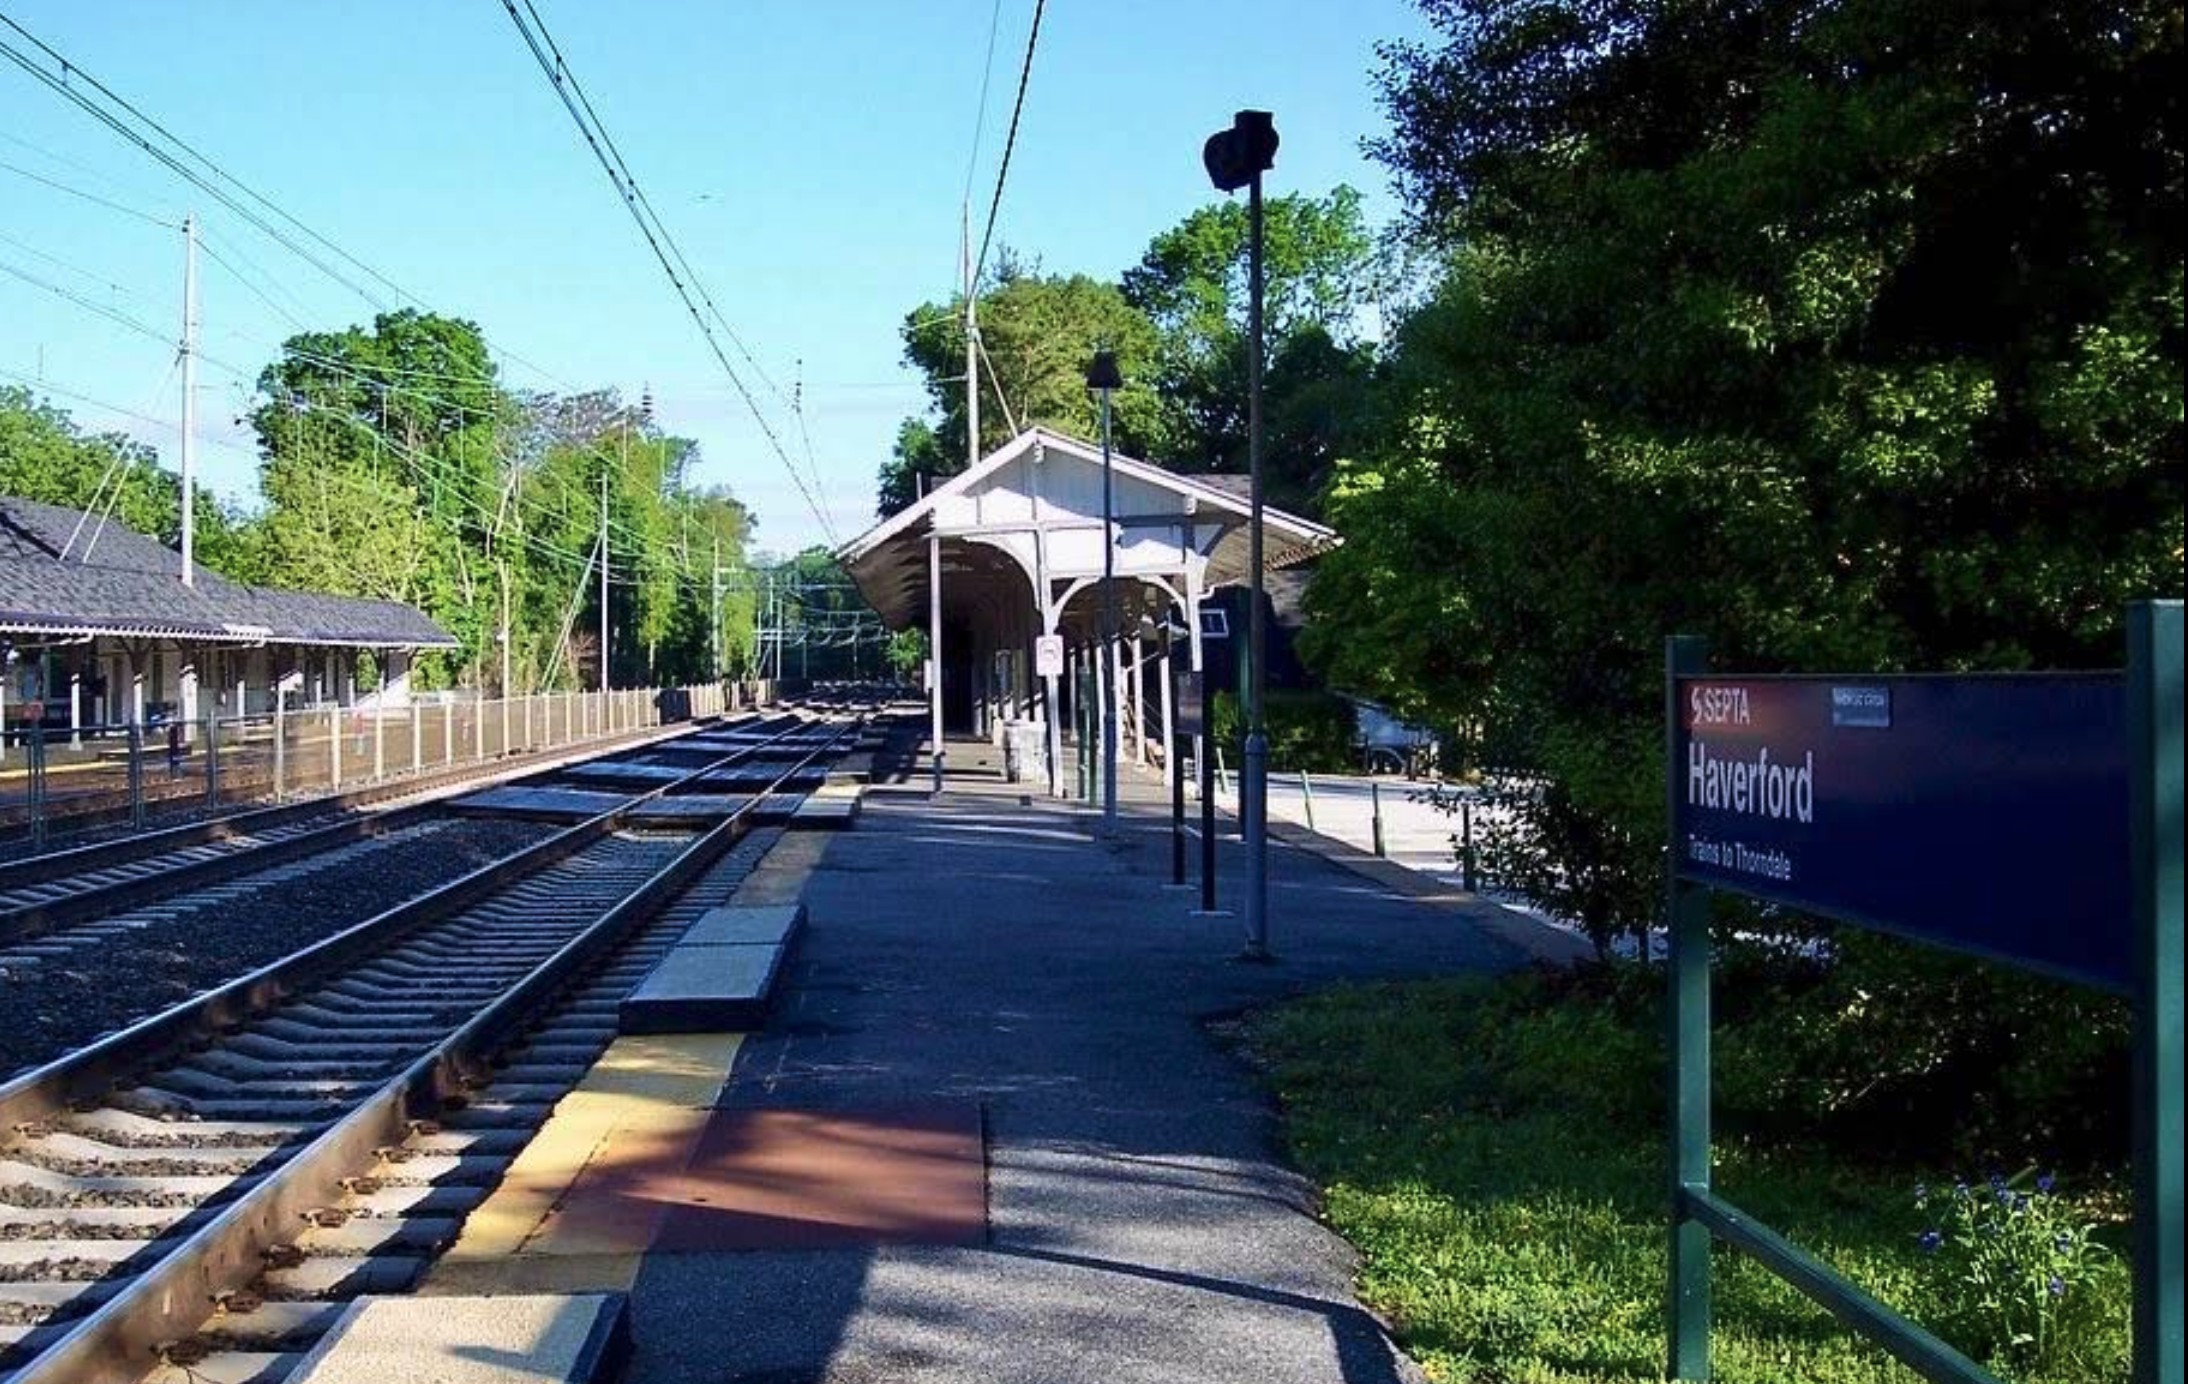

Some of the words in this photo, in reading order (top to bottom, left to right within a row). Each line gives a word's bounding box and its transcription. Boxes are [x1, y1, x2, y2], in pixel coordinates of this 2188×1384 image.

[1704, 687, 1750, 725] SEPTA
[1689, 742, 1812, 823] Haverford
[1722, 841, 1733, 868] to
